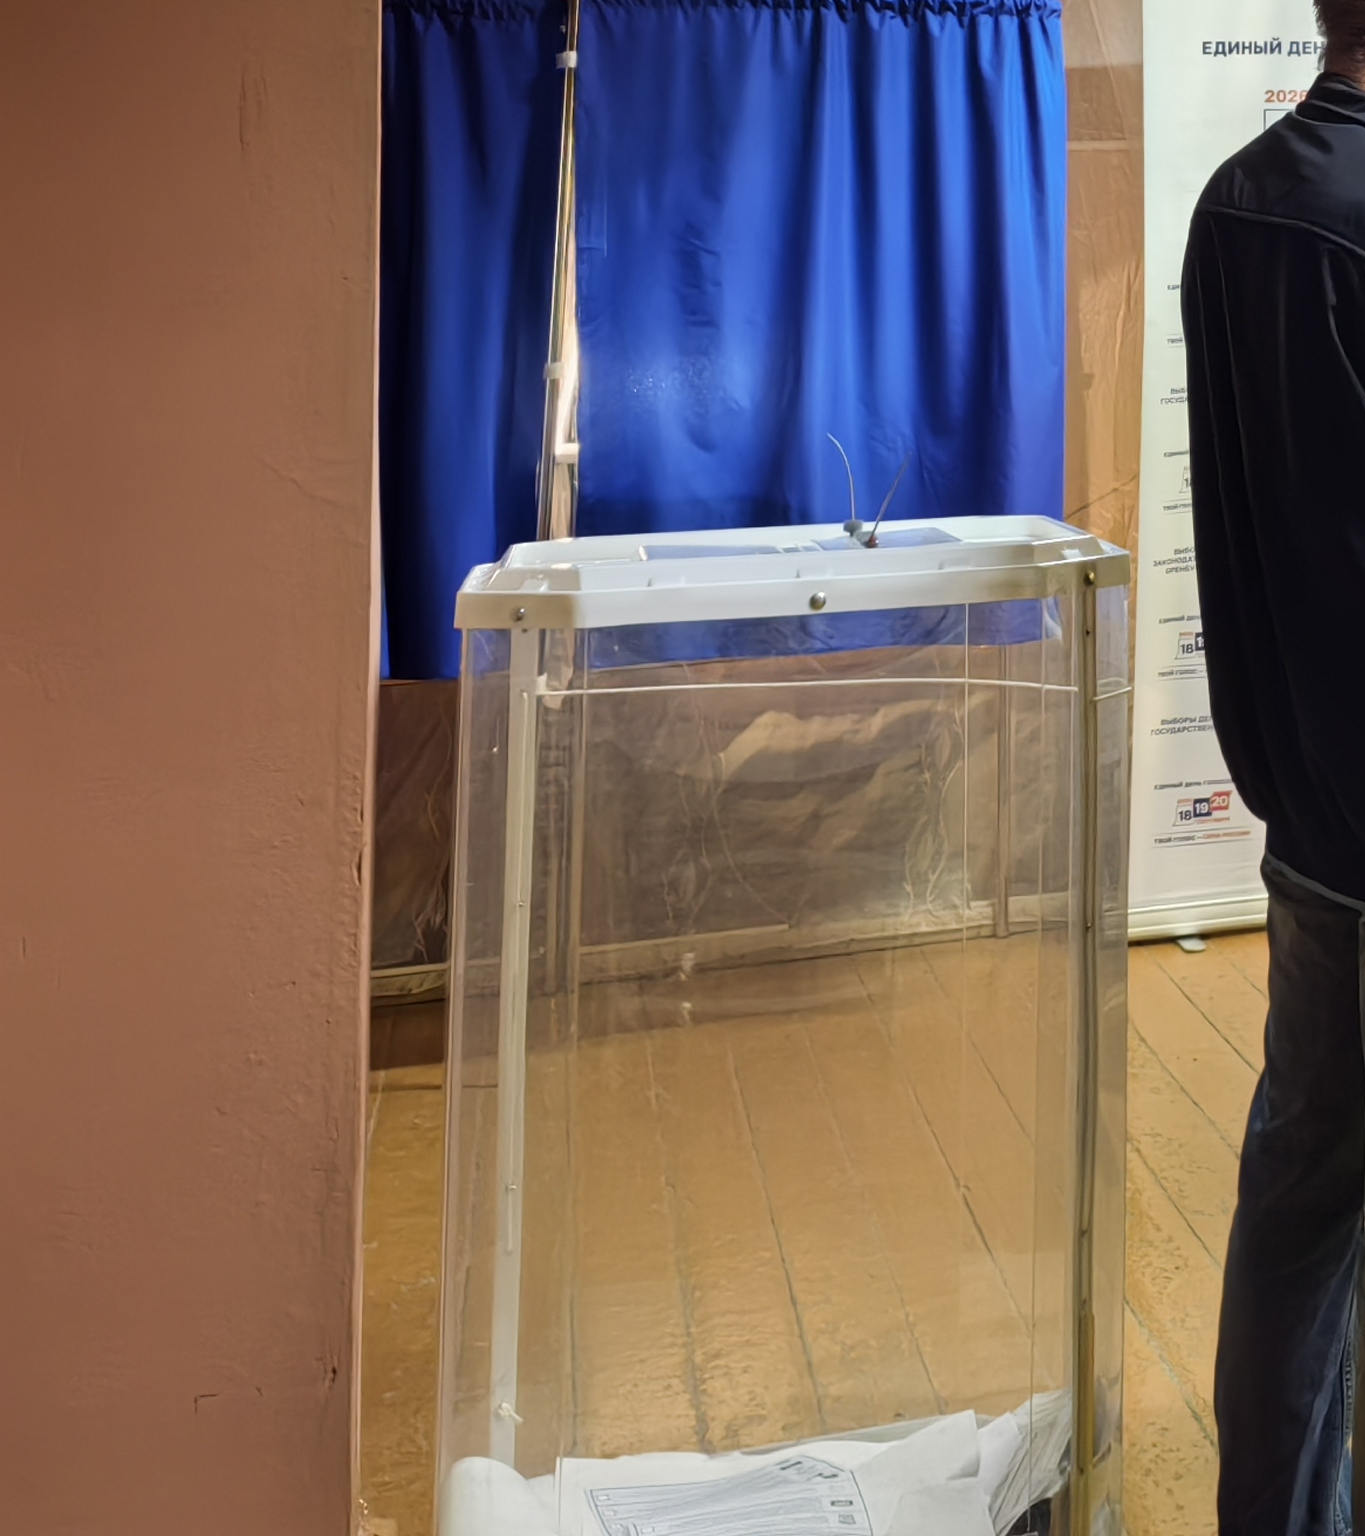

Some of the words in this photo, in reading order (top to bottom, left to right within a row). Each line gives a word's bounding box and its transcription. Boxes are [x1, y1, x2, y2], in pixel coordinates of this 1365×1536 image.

[1202, 37, 1282, 57] ЕДИНЫЙ
[1180, 643, 1194, 654] 18
[1178, 810, 1192, 821] 18
[1194, 802, 1209, 814] 19
[1211, 795, 1228, 807] 20
